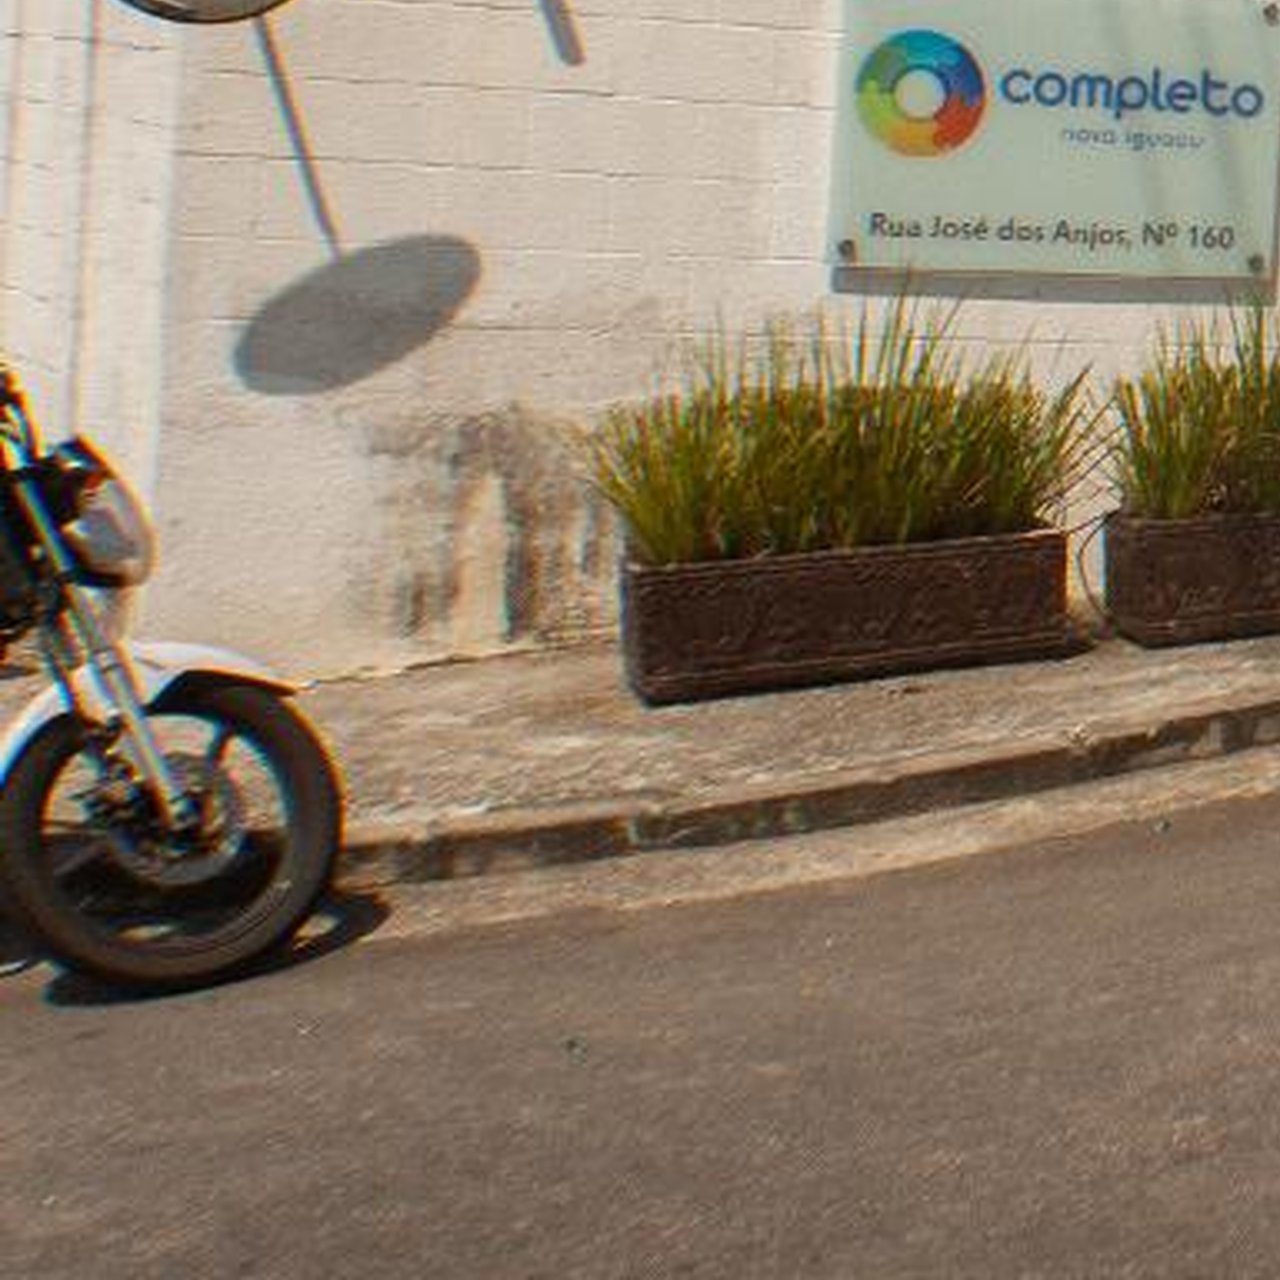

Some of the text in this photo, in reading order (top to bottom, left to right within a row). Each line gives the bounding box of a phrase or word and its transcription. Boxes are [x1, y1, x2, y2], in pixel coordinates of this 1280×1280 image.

[1000, 66, 1264, 121] completo
[870, 212, 922, 239] Rua
[928, 215, 989, 241] José
[997, 216, 1045, 243] dos
[1052, 219, 1133, 252] Anjos,
[1188, 224, 1235, 251] 160
